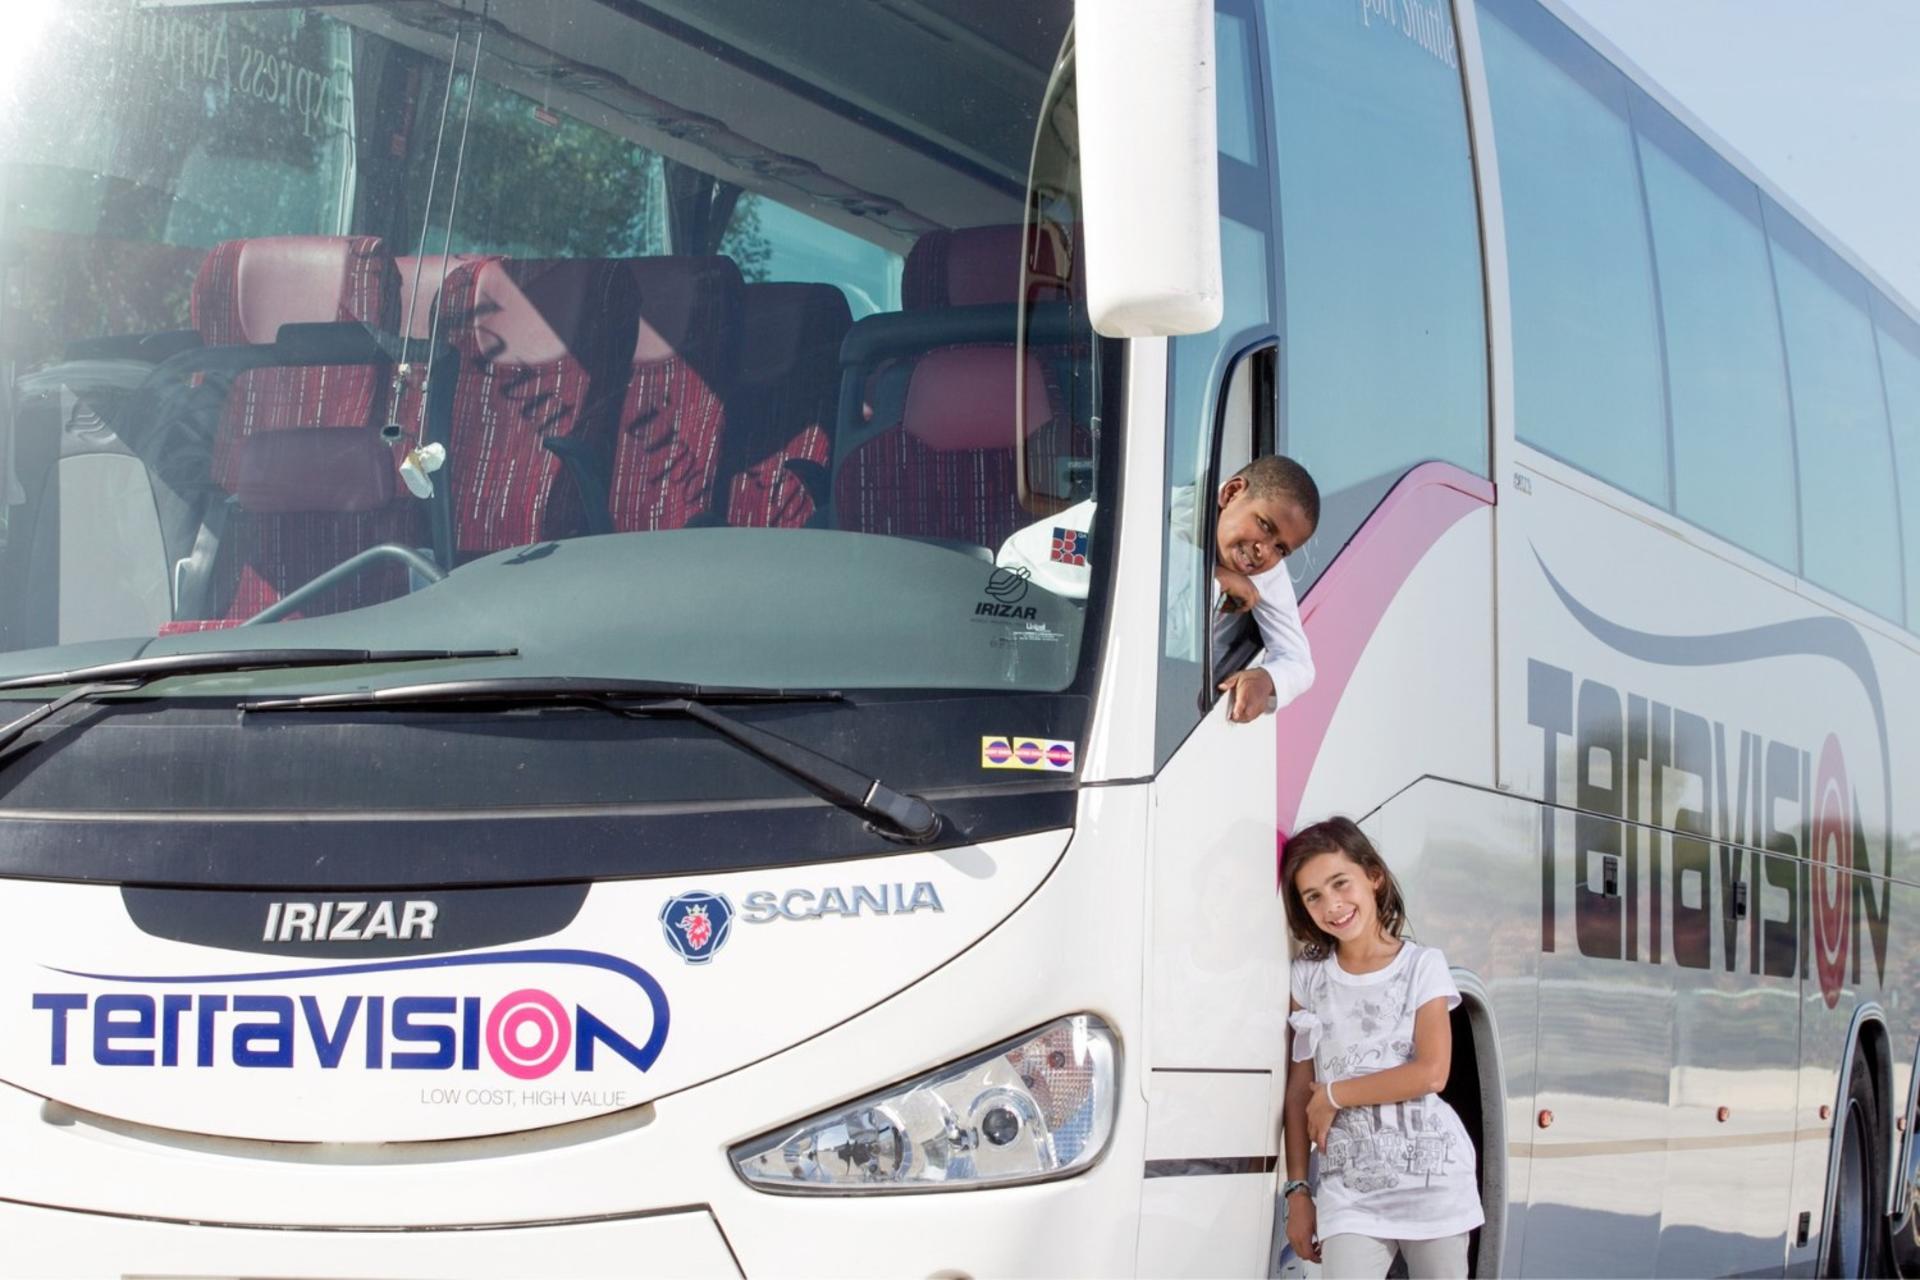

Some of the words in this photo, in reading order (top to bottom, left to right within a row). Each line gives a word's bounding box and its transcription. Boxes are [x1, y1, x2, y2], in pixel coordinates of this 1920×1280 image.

[975, 602, 1037, 620] IRIZAR
[741, 881, 945, 924] SCANIA
[262, 900, 438, 942] IRIZAR
[420, 1088, 461, 1104] LOW
[465, 1088, 517, 1107] COST,
[522, 1090, 566, 1106] HIGH
[570, 1090, 627, 1107] VALUE
